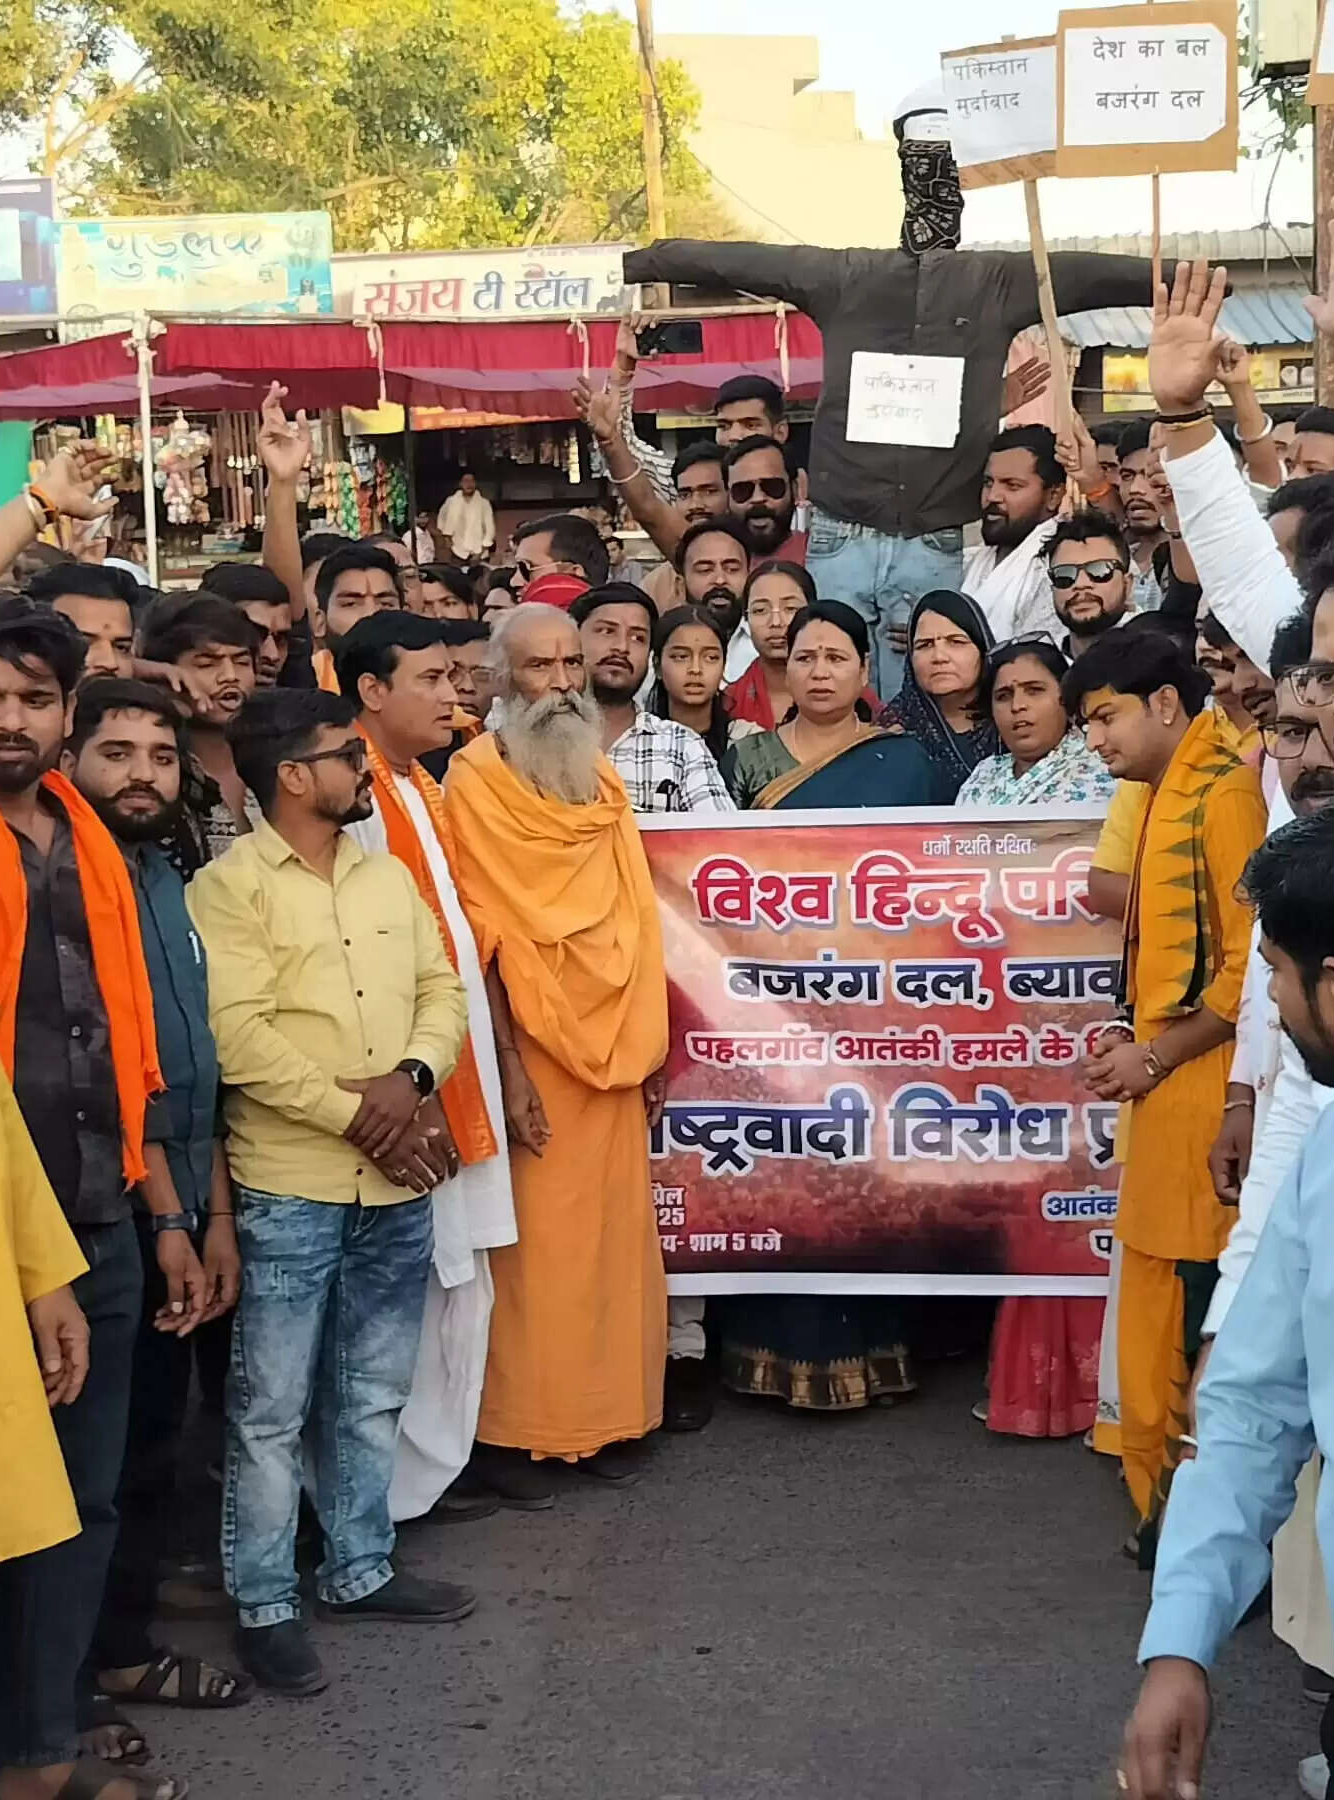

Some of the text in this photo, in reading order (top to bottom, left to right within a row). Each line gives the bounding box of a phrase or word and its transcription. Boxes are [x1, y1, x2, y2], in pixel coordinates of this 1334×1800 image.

[1093, 37, 1210, 61] देश का बल
[1096, 84, 1205, 110] बजरंग दल
[364, 268, 593, 314] संजय टी स्टॉल
[690, 848, 1099, 941] विश्व हिन्दू परि
[726, 952, 1123, 1005] बजरंग दल, ब्याव
[835, 1029, 942, 1062] आतंकी
[951, 1028, 1030, 1066] हमले
[1039, 1028, 1075, 1062] के
[650, 1086, 869, 1172] ाष्ट्रवादी
[888, 1086, 1067, 1159] विरोध
[658, 1207, 685, 1227] 25
[1046, 1189, 1118, 1217] आतंक
[689, 1232, 729, 1252] शाम
[731, 1232, 746, 1252] 5
[749, 1227, 783, 1252] बजे
